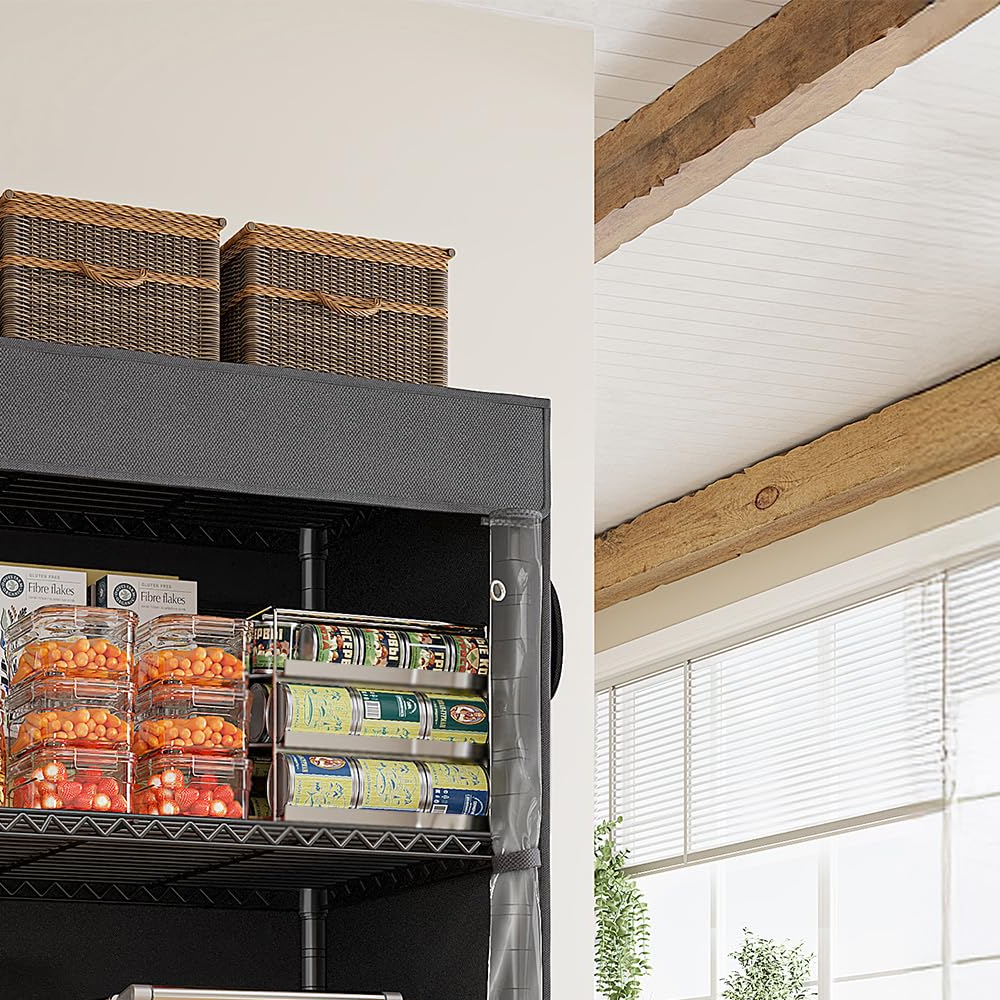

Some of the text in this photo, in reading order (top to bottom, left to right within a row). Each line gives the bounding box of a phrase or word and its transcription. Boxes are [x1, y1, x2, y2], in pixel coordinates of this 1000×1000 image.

[28, 582, 75, 596] Fibre flakes
[140, 591, 186, 605] Fibre flakes
